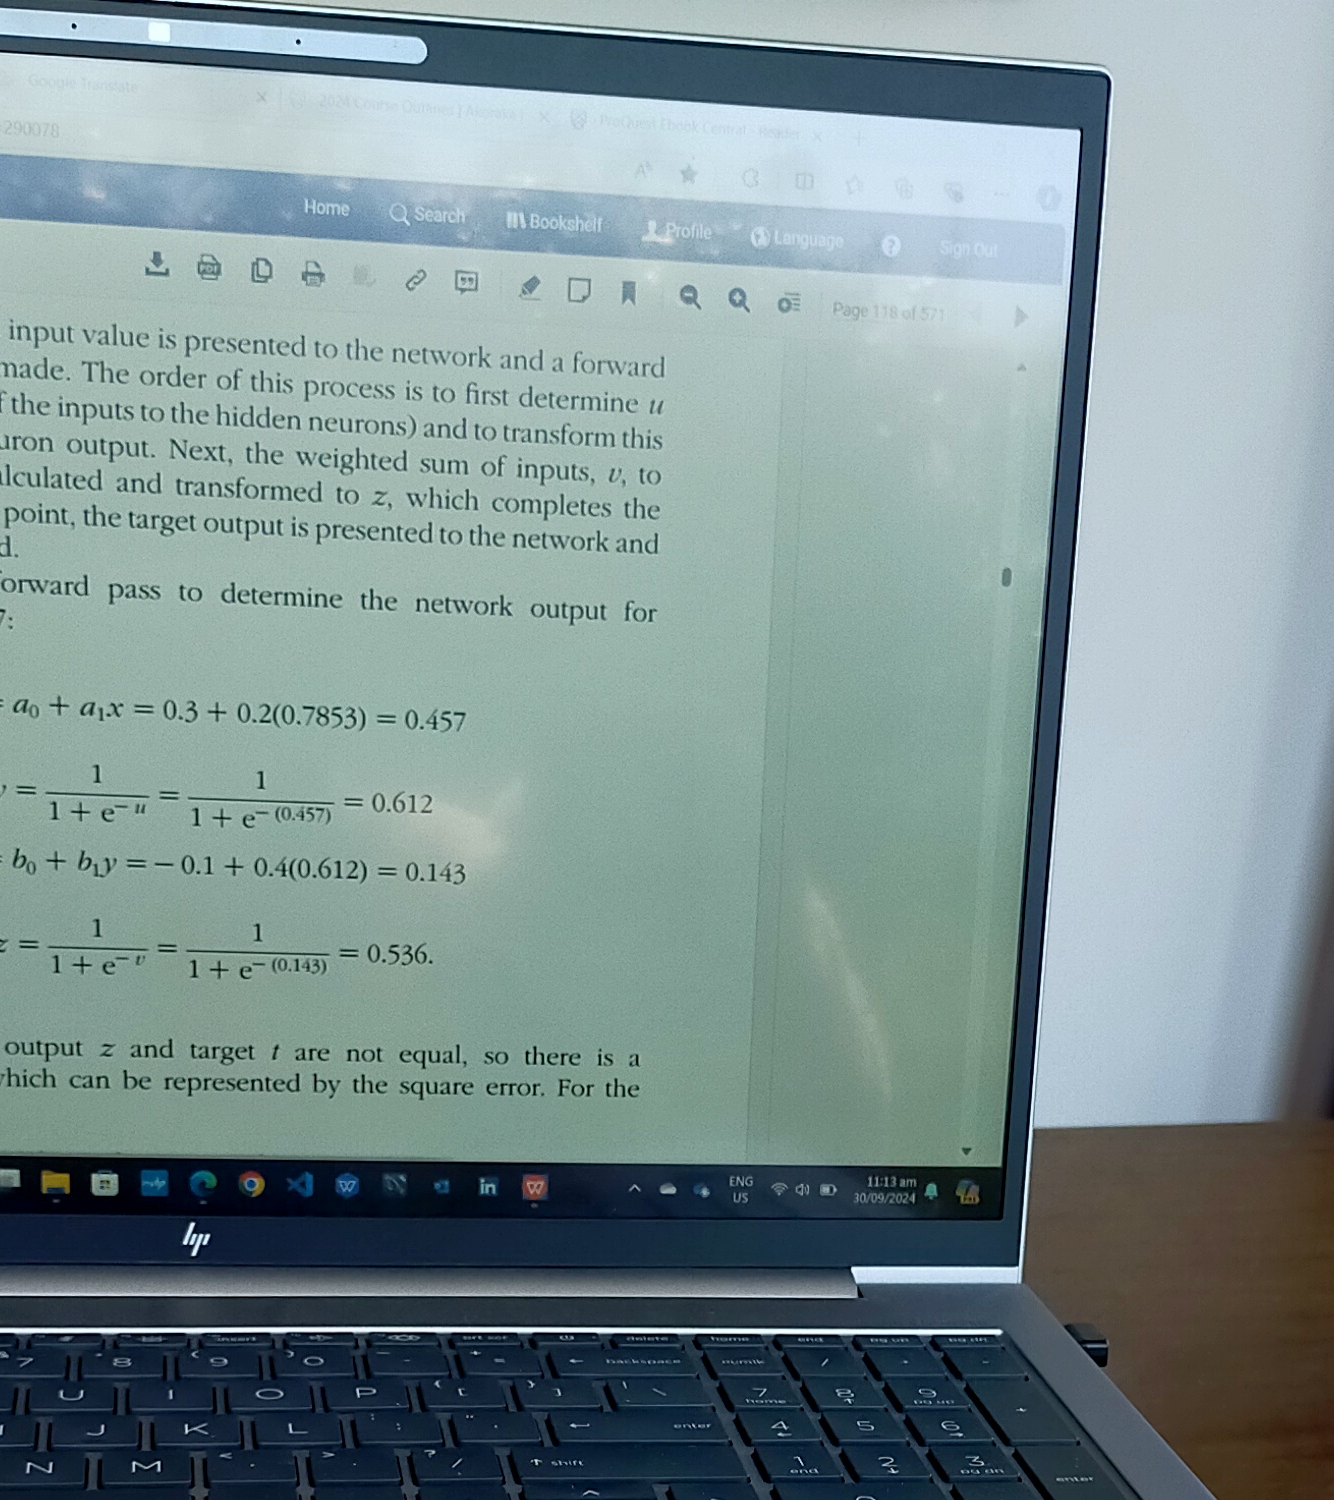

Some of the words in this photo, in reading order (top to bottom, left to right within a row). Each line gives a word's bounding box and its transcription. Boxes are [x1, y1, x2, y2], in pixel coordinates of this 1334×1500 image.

[303, 198, 351, 217] Home
[413, 205, 467, 225] Search
[529, 213, 604, 234] Bookshelf
[665, 221, 713, 241] Profile
[773, 229, 845, 251] Language
[831, 300, 868, 322] Page
[902, 304, 917, 321] of
[920, 305, 946, 322] 571
[8, 318, 75, 350] input
[81, 322, 150, 349] value
[158, 327, 178, 350] is
[184, 334, 307, 358] presented
[313, 340, 339, 359] to
[345, 337, 384, 363] the
[391, 344, 492, 369] network
[499, 348, 544, 372] and
[551, 356, 564, 373] a
[572, 350, 666, 379] forward
[80, 359, 130, 385] The
[138, 364, 208, 390] order
[216, 367, 244, 391] of
[250, 369, 294, 394] this
[303, 379, 396, 403] process
[405, 379, 424, 402] is
[431, 384, 456, 404] to
[465, 381, 509, 407] first
[518, 384, 639, 414] determine
[648, 398, 665, 416] u
[65, 437, 156, 464] output.
[169, 437, 233, 465] Next,
[245, 440, 285, 466] the
[295, 446, 408, 476] weighted
[419, 457, 469, 476] sum
[480, 454, 508, 478] of
[516, 457, 596, 487] inputs,
[638, 467, 662, 486] to
[3, 502, 76, 530] point,
[82, 503, 122, 529] the
[127, 510, 197, 538] target
[202, 516, 284, 542] output
[290, 515, 310, 538] is
[315, 521, 434, 546] presented
[439, 526, 464, 545] to
[468, 523, 506, 548] the
[512, 529, 610, 553] network
[615, 532, 659, 555] and
[107, 582, 162, 606] pass
[178, 583, 204, 603] to
[220, 581, 344, 610] determine
[360, 587, 399, 612] the
[415, 593, 514, 617] network
[529, 601, 607, 627] output
[624, 599, 659, 623] for
[3, 1039, 83, 1063] output
[99, 1042, 116, 1058] z
[129, 1037, 174, 1059] and
[189, 1043, 255, 1066] target
[271, 1043, 280, 1061] t
[294, 1047, 331, 1062] are
[346, 1046, 383, 1063] not
[398, 1043, 468, 1070] equal,
[483, 1050, 510, 1065] so
[524, 1044, 582, 1067] there
[597, 1047, 614, 1067] is
[628, 1053, 641, 1068] a
[68, 1074, 111, 1090] can
[122, 1068, 152, 1091] be
[163, 1072, 301, 1098] represented
[312, 1072, 342, 1100] by
[352, 1073, 389, 1095] the
[399, 1080, 475, 1102] square
[485, 1082, 546, 1097] error.
[557, 1078, 596, 1098] For
[605, 1077, 641, 1099] the
[728, 1175, 754, 1188] ENG
[866, 1175, 897, 1189] 11:13
[899, 1177, 918, 1189] am
[732, 1192, 749, 1204] US
[852, 1191, 917, 1206] 30/09/2024
[181, 1220, 212, 1258] hp
